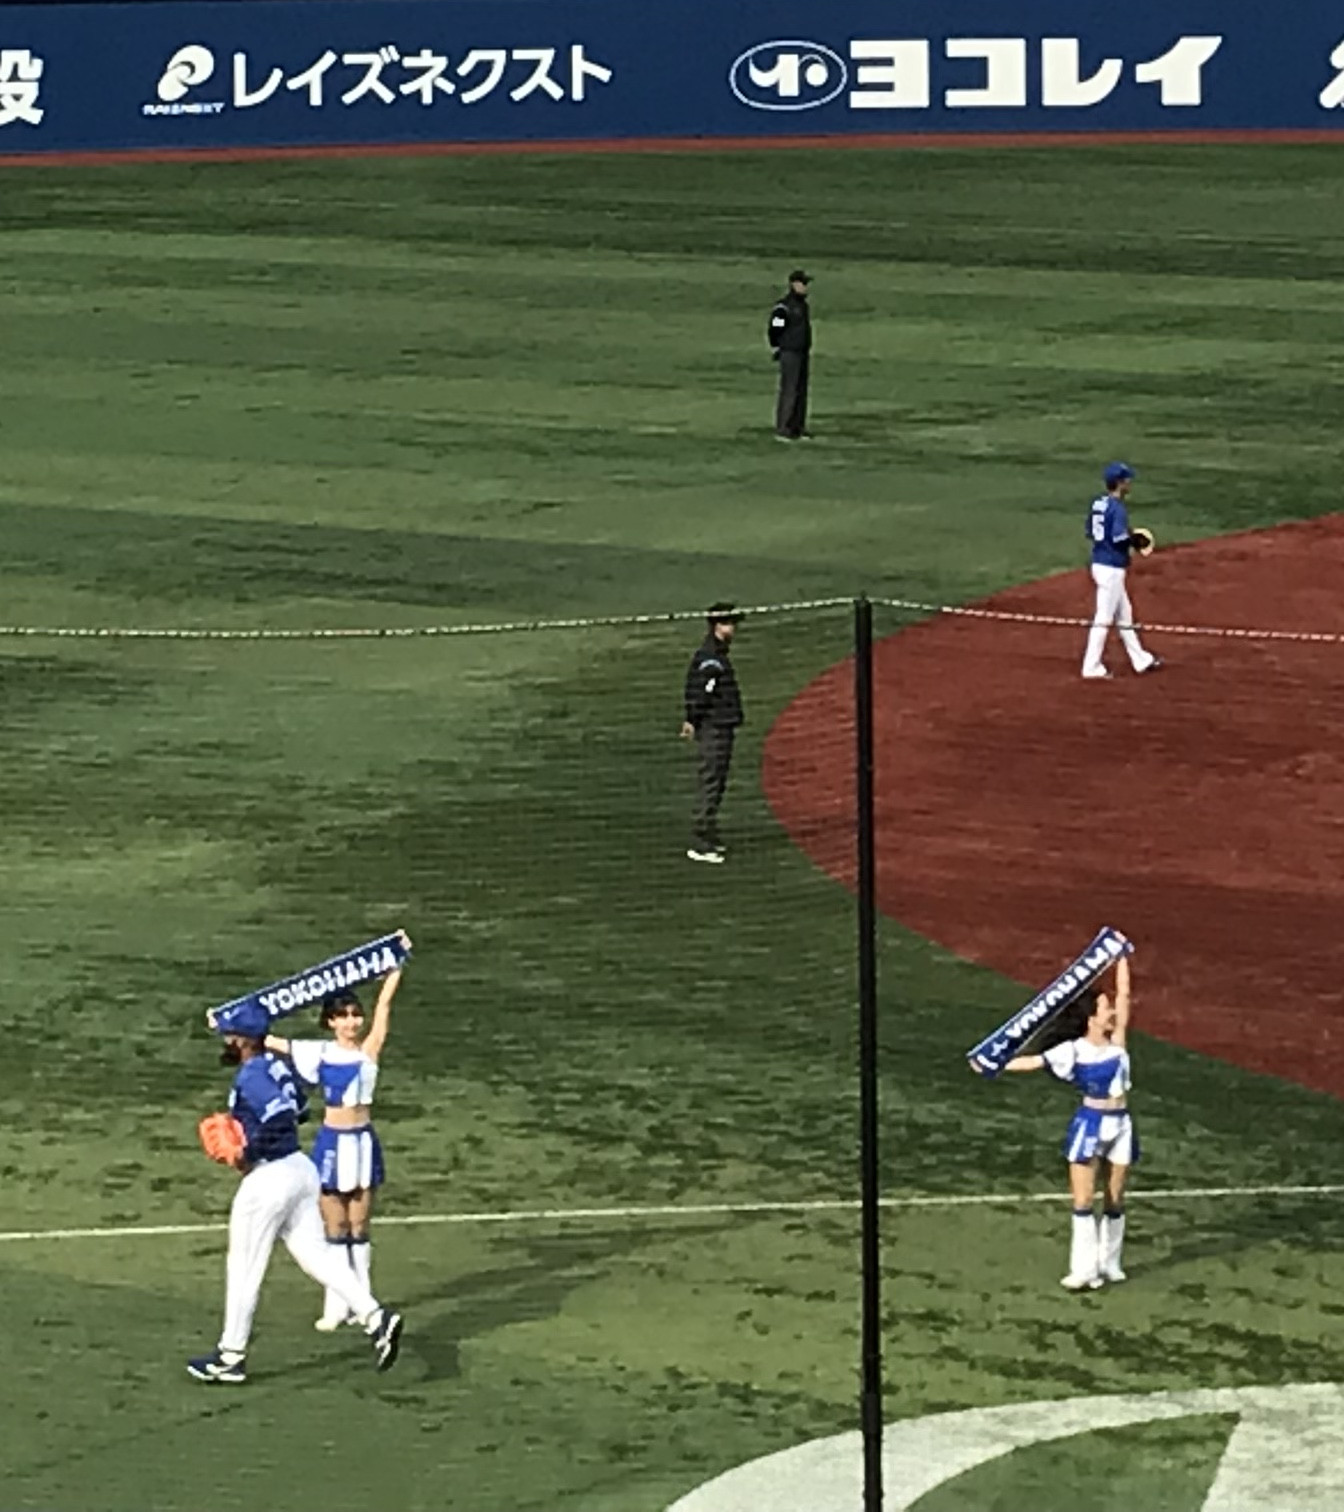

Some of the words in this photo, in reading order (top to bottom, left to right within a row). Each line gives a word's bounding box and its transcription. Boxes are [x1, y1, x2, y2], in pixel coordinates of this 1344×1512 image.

[232, 44, 613, 108] レイズネクスト
[849, 35, 1223, 108] ヨコレイ
[259, 946, 398, 1016] YOKOHAMA
